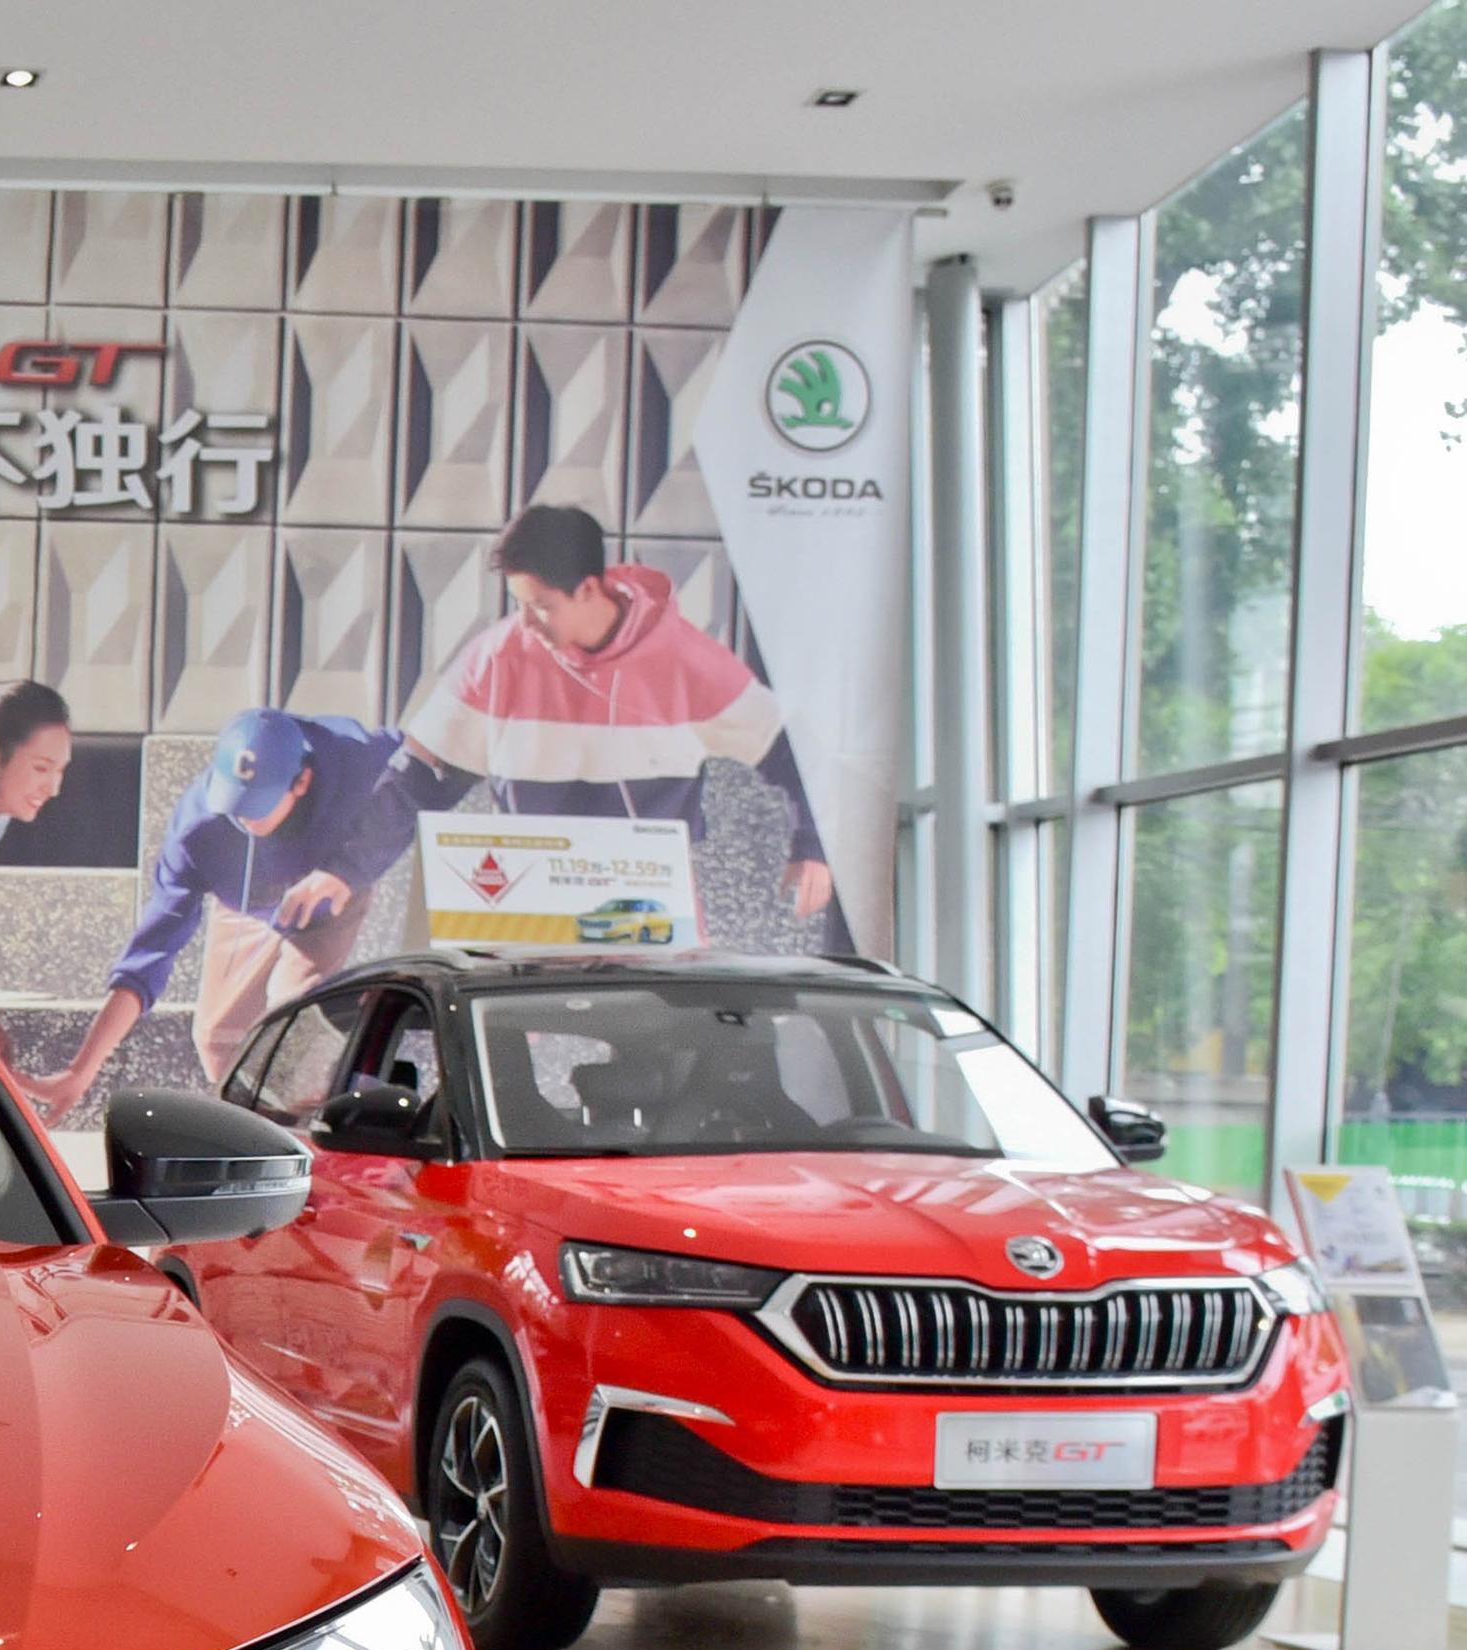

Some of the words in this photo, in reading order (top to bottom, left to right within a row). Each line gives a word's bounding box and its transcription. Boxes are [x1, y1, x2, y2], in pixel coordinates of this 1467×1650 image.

[748, 471, 884, 500] ŠKODA
[965, 1438, 1126, 1464] 柯米克GT
